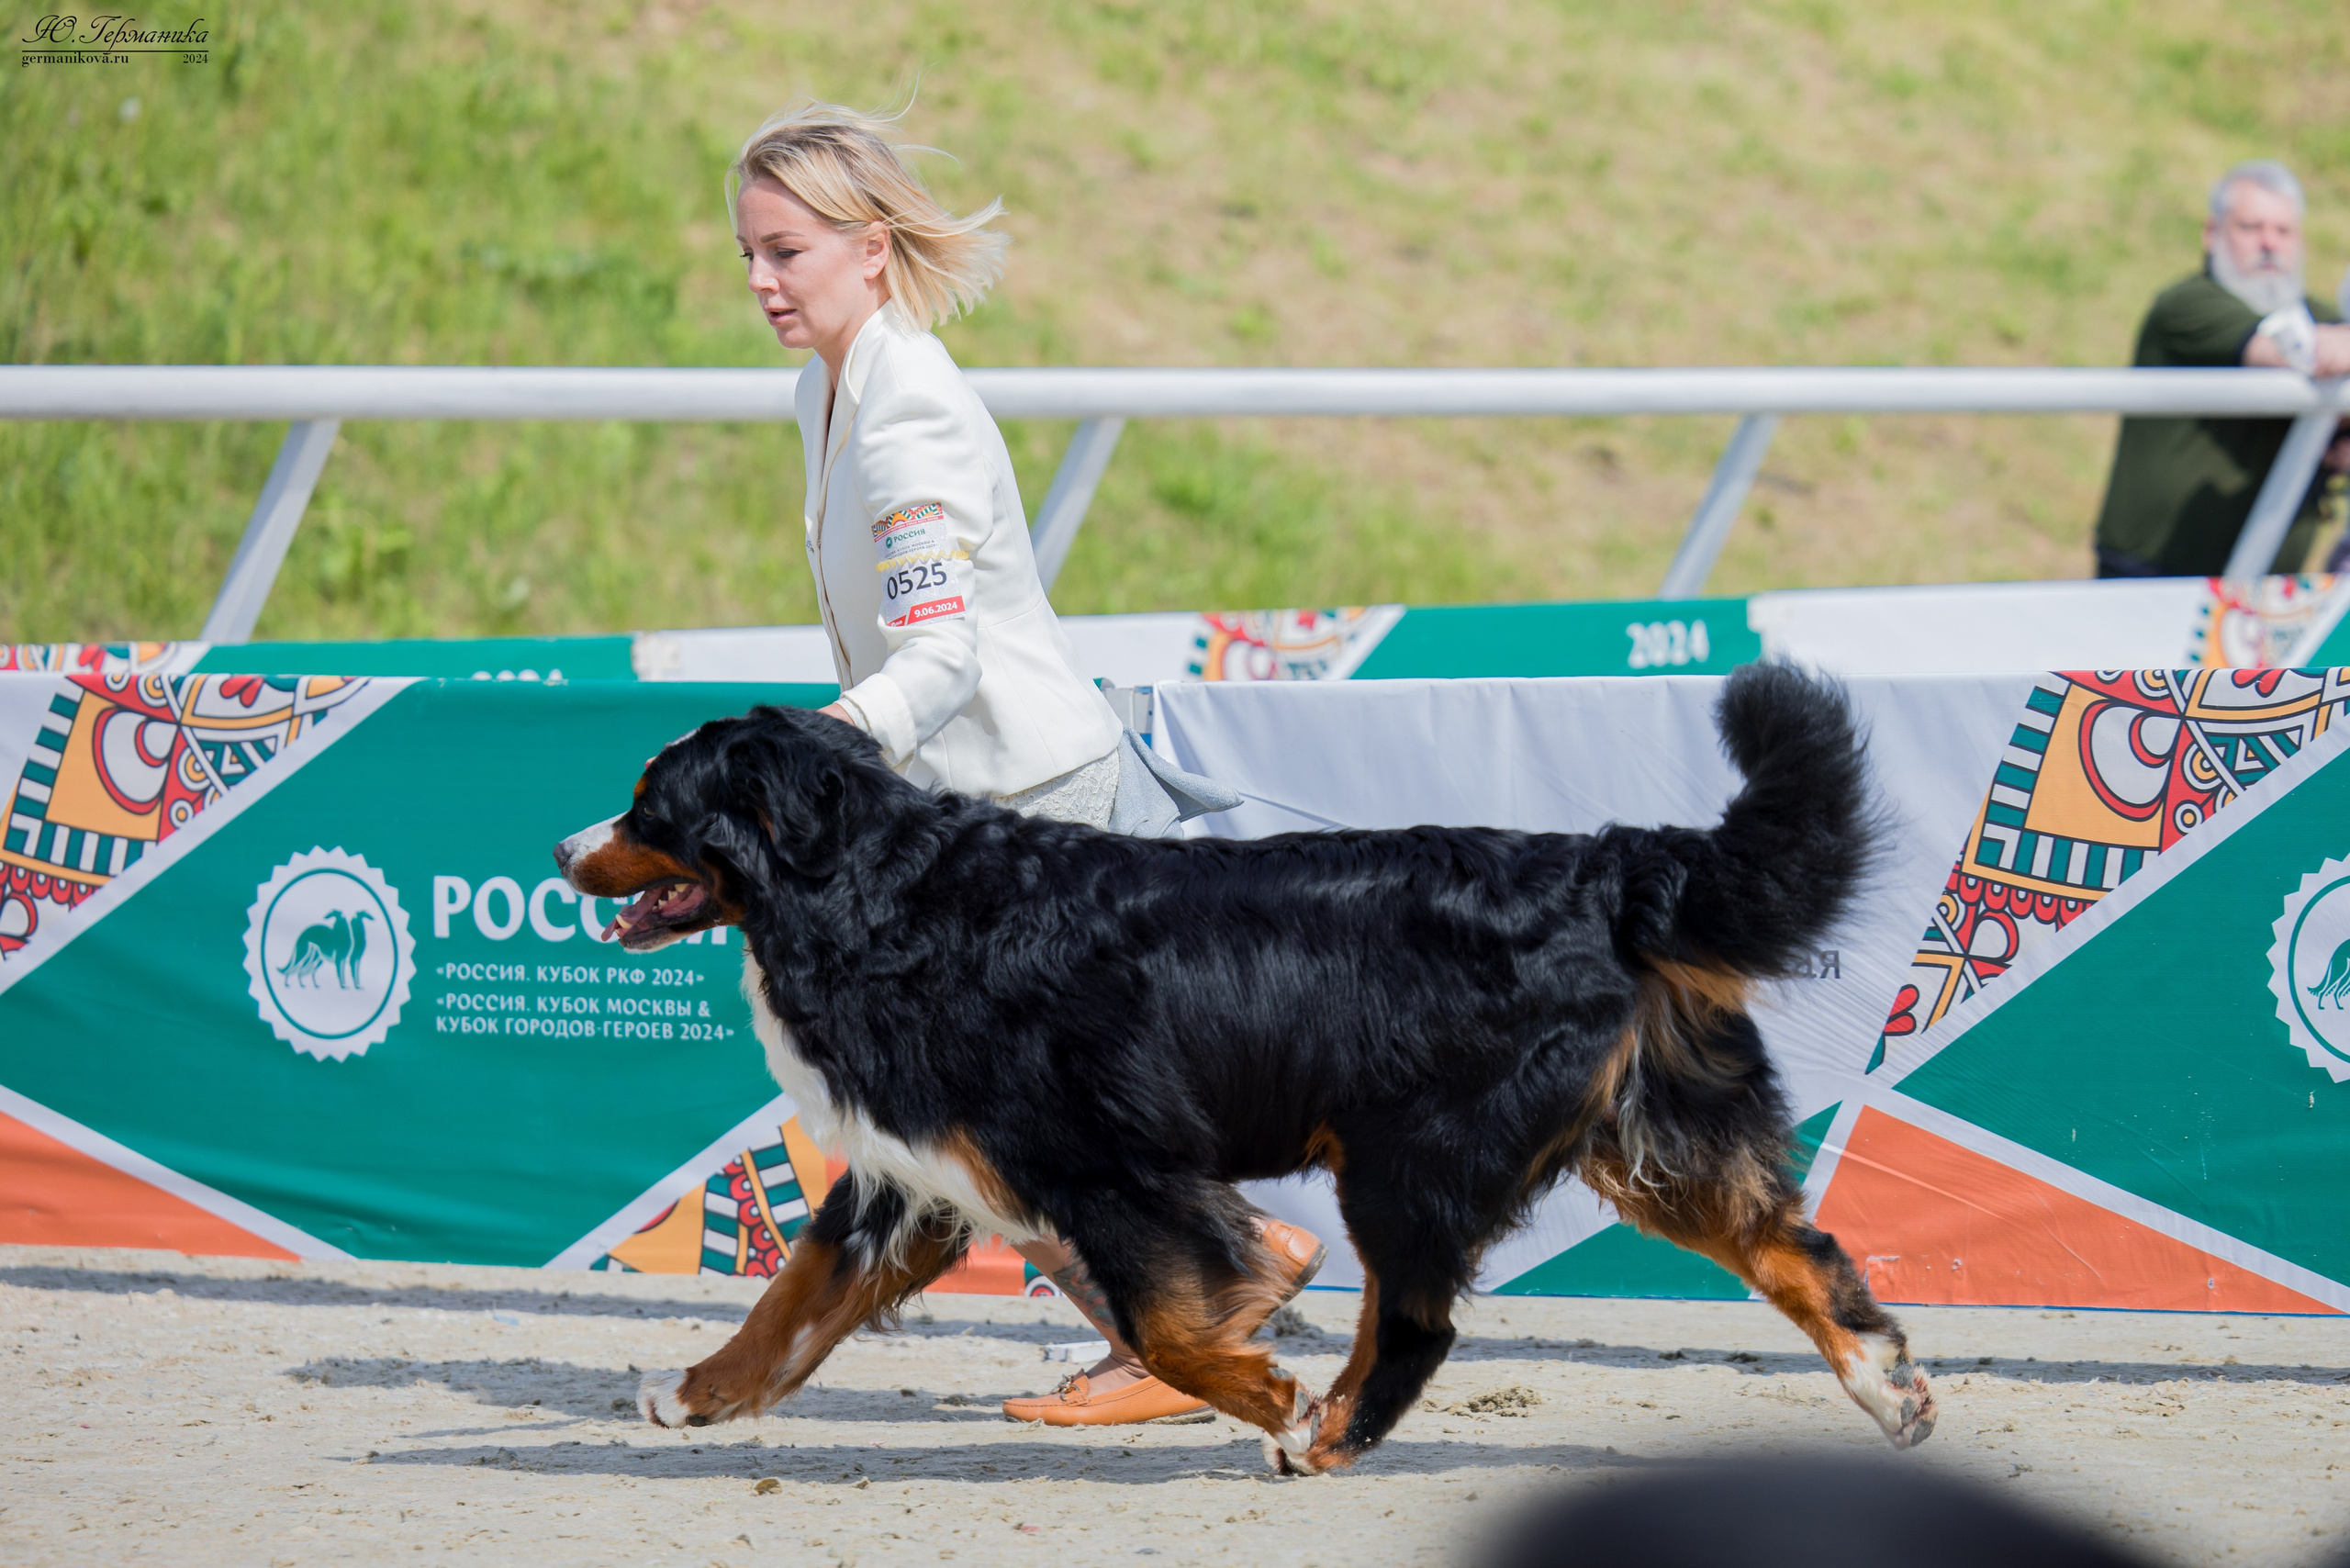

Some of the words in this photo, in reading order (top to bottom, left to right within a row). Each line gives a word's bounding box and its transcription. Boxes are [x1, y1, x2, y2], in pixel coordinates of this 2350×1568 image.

[893, 528, 926, 543] РОССИЯ
[887, 562, 947, 600] 0525
[914, 600, 957, 619] 9.06.2024
[537, 965, 600, 984] КУБОК
[607, 967, 645, 985] РКФ
[652, 968, 705, 986] 2024»
[537, 995, 600, 1014] КУБОК
[607, 997, 692, 1017] МОСКВЫ
[698, 999, 711, 1018] &
[436, 1015, 498, 1035] КУБОК
[506, 1017, 674, 1039] ГОРОДОВ-ГЕРОЕВ
[679, 1021, 735, 1041] 2024»
